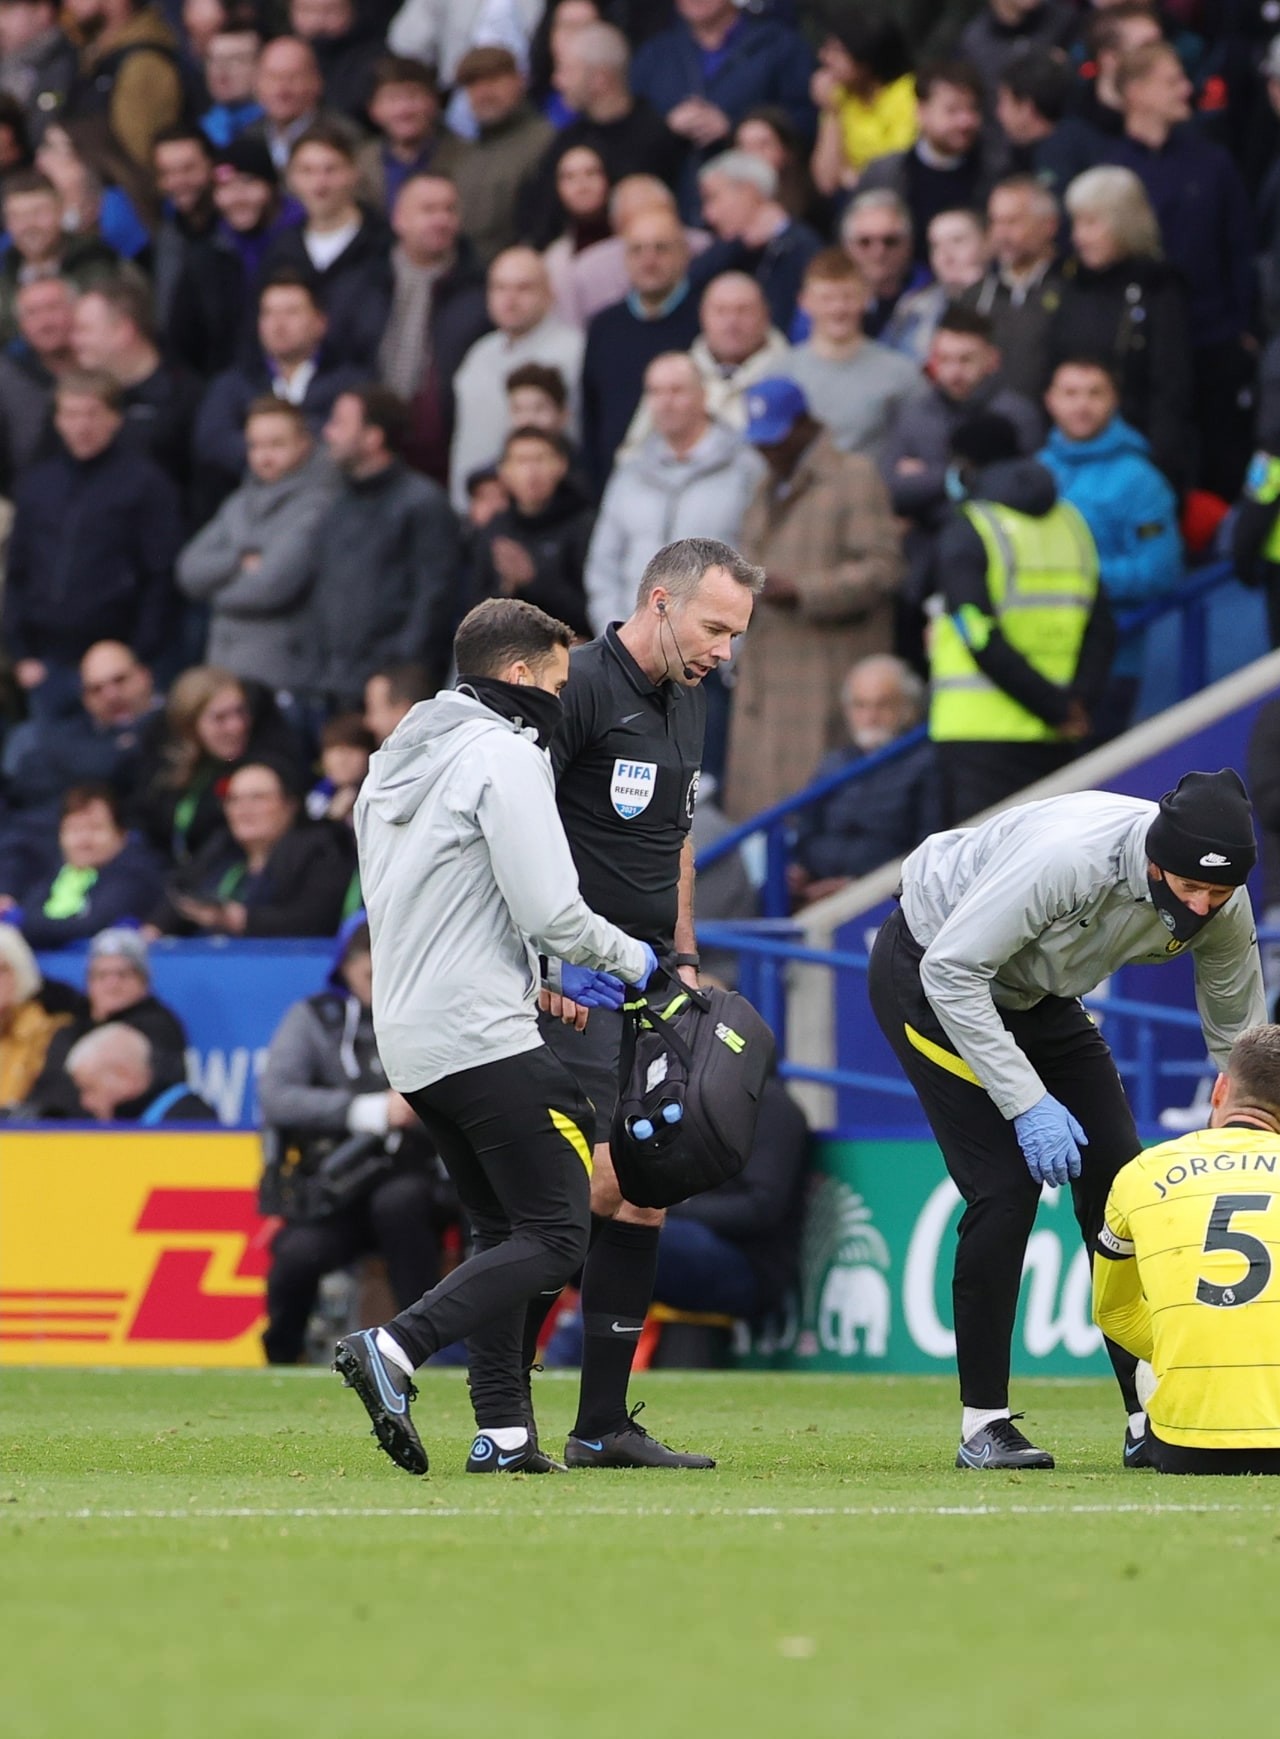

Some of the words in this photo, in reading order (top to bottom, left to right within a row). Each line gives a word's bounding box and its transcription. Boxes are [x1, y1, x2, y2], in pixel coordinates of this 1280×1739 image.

[618, 764, 651, 780] FIFA
[615, 786, 649, 797] REFEREE
[1195, 1194, 1273, 1308] 5
